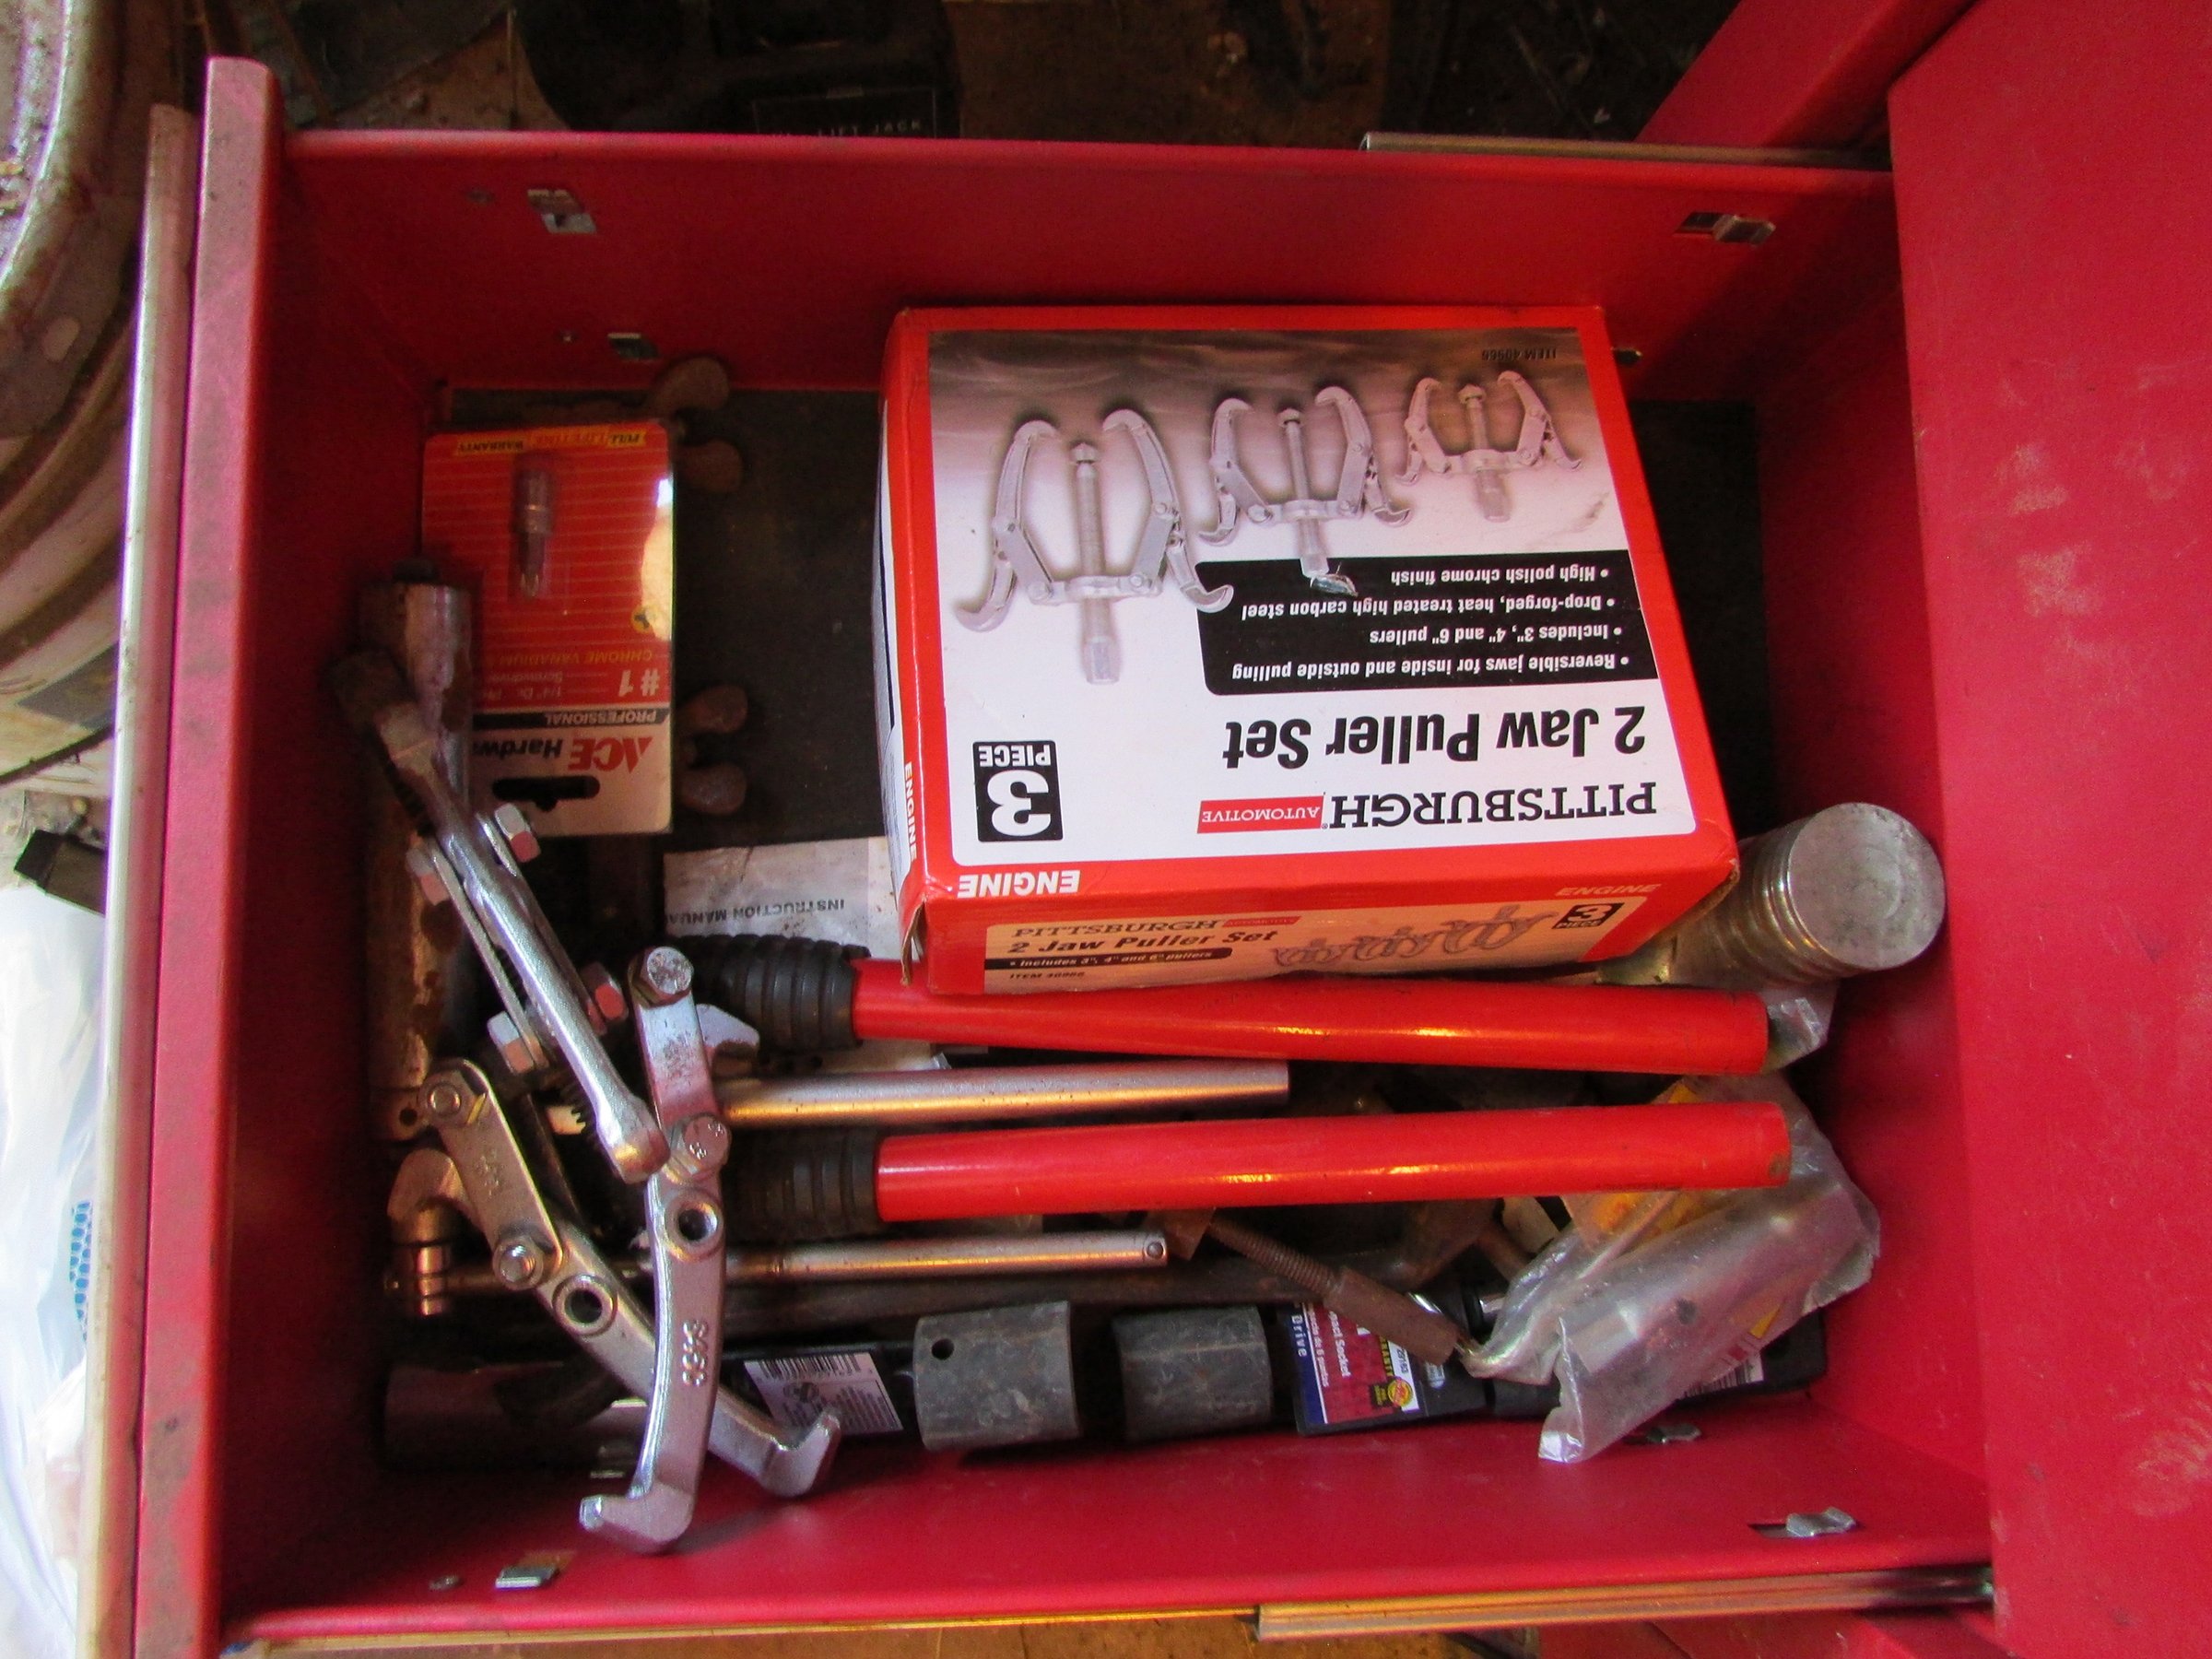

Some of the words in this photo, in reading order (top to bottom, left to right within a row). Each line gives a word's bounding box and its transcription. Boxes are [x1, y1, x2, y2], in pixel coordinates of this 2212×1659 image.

[1391, 571, 1436, 586] finish
[1441, 570, 1500, 585] chrome
[1505, 566, 1555, 585] polish
[1560, 564, 1595, 582] High
[1241, 604, 1285, 619] steel
[1289, 601, 1347, 618] carbon
[1352, 598, 1388, 618] high
[1394, 599, 1453, 616] treated
[1457, 599, 1494, 615] heat
[1500, 594, 1602, 613] Drop-forged,
[1370, 628, 1427, 645] pullers
[1432, 629, 1450, 643] 6"
[1454, 629, 1484, 643] and
[1489, 628, 1506, 642] 4"
[1539, 624, 1608, 640] Includes
[500, 652, 580, 665] VANADIUM
[585, 649, 653, 662] CHROME
[1486, 654, 1524, 673] jaws
[1529, 653, 1615, 673] Reversible
[1232, 663, 1292, 681] pulling
[1297, 662, 1360, 679] outside
[1366, 661, 1395, 677] and
[1402, 659, 1452, 677] inside
[1456, 658, 1480, 675] for
[544, 711, 657, 725] PROFESSIONAL
[1496, 709, 1599, 757] Jaw
[1615, 706, 1645, 754] 2
[1222, 719, 1312, 770] Set
[1326, 713, 1479, 765] Puller
[568, 736, 653, 773] ACE
[979, 744, 1051, 767] PIECE
[904, 762, 917, 860] ENGINE
[987, 770, 1051, 837] 3
[1330, 782, 1657, 829] PITTSBURGH
[1202, 806, 1321, 823] AUTOMOTIVE
[958, 870, 1081, 898] ENGINE
[1556, 884, 1662, 896] ENGINE
[734, 899, 845, 920] INSTRUCTION
[1568, 905, 1613, 921] 3
[1012, 920, 1218, 937] PITTSBURGH
[1556, 920, 1602, 928] PIECE
[1007, 942, 1030, 953] 2
[1039, 938, 1105, 951] Jaw
[1114, 934, 1215, 948] Puller
[1222, 931, 1277, 943] Set
[1020, 959, 1077, 967] Includes
[1121, 955, 1145, 963] and
[1166, 951, 1212, 960] pullers
[1291, 1314, 1307, 1357] Drive
[1335, 1339, 1351, 1377] Socket
